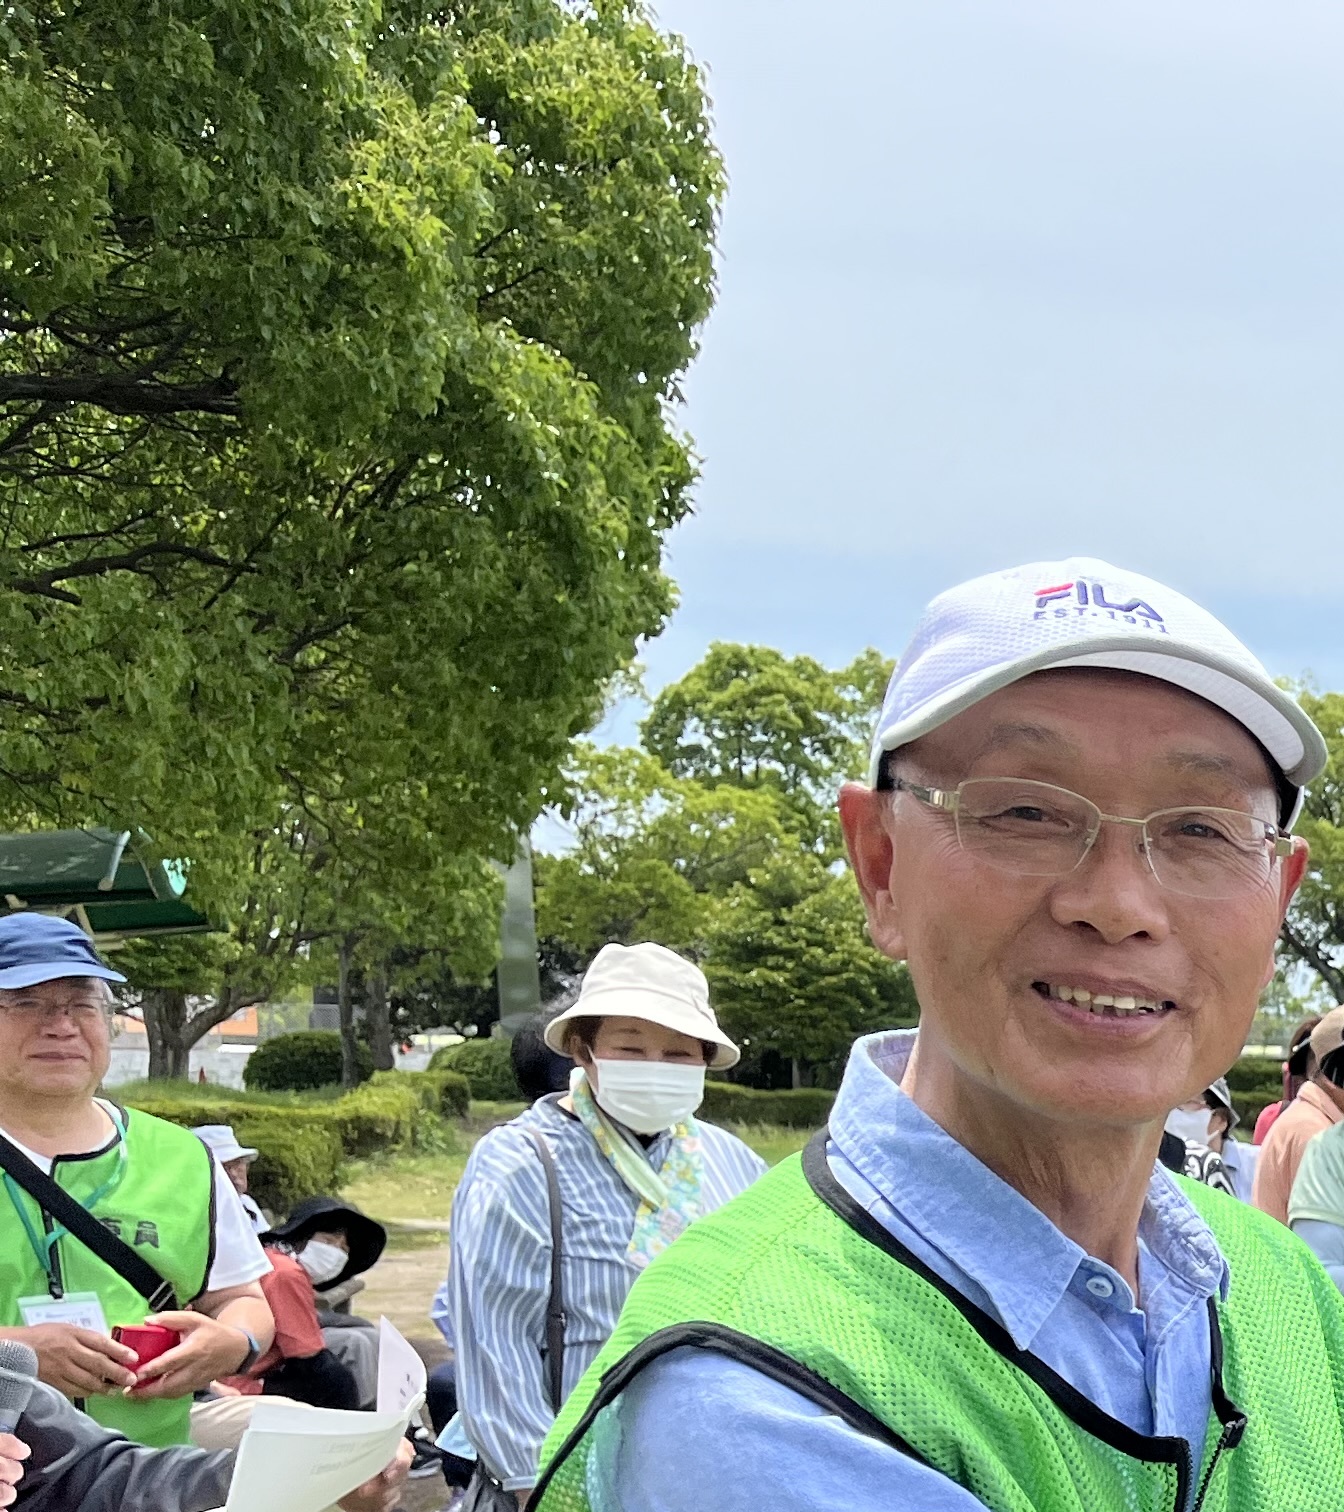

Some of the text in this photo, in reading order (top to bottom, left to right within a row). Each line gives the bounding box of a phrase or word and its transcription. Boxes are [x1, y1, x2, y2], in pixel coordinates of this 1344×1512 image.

[1034, 580, 1164, 623] FILA
[1034, 607, 1171, 635] EST. 1911
